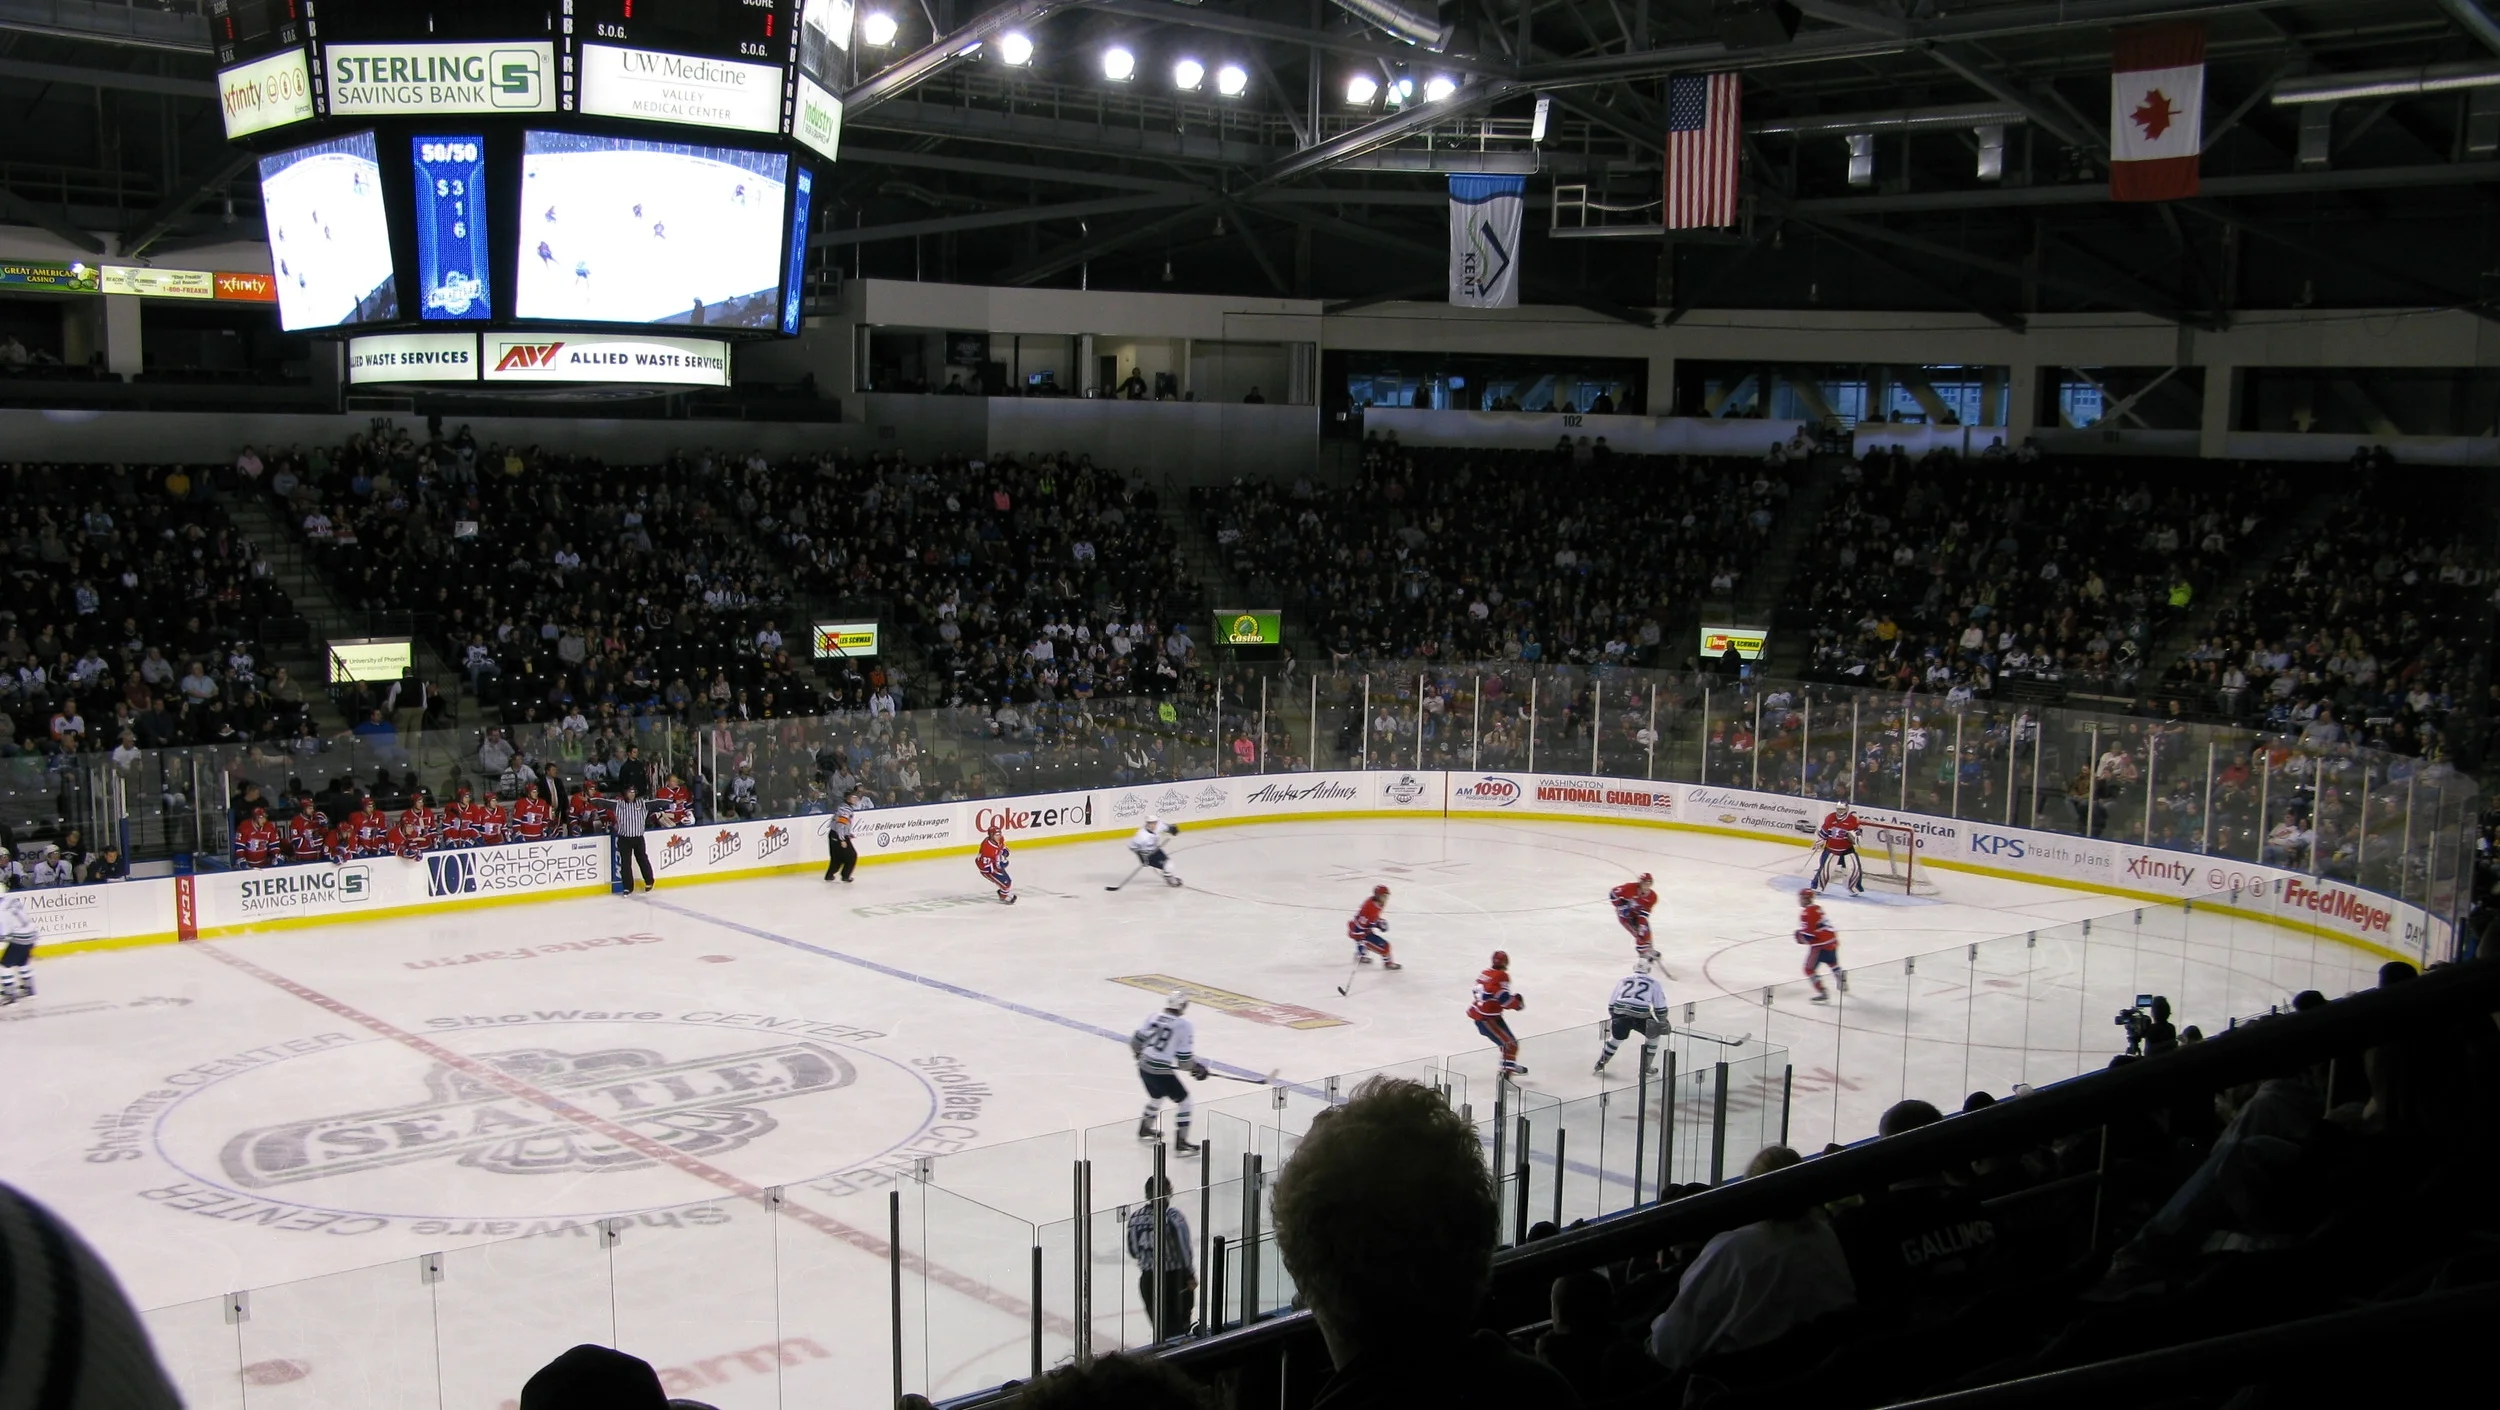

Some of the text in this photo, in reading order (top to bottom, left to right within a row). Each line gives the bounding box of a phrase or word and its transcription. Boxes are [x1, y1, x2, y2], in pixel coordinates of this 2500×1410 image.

[598, 23, 628, 39] S.O.G.
[740, 42, 768, 57] S.O.G.
[337, 56, 485, 83] STERLING
[622, 51, 747, 86] UW Medicine
[224, 80, 263, 118] xfinity
[337, 85, 486, 105] SAVINGS BANK
[662, 88, 705, 102] VALLEY
[632, 100, 732, 121] MEDICAL CENTER
[421, 143, 478, 163] 50/50
[452, 179, 465, 196] 3
[455, 201, 464, 216] 1
[453, 221, 467, 239] 6
[4, 266, 77, 279] GREAT AMERICAN
[27, 275, 56, 284] CASINO
[1464, 253, 1476, 300] KENT
[222, 278, 266, 294] xfinity
[365, 353, 397, 367] WASTE
[400, 351, 469, 365] SERVICES
[570, 352, 724, 371] ALLIED WASTE SERVICES
[1562, 415, 1583, 427] 102
[1229, 633, 1263, 642] Casino
[1247, 783, 1299, 804] Alaska
[1299, 780, 1357, 800] Airlines
[1455, 782, 1514, 796] AM 1090
[1539, 778, 1604, 789] WASHINGTON
[1537, 786, 1652, 807] NATIONAL GUARD
[1688, 789, 1740, 808] Chaplins
[1739, 801, 1758, 811] North
[1758, 803, 1776, 812] Bend
[1776, 805, 1807, 816] Chevrolet
[874, 820, 906, 832] Bellevue
[907, 816, 950, 830] Volkswagen
[1741, 816, 1794, 831] chaplins.com
[757, 830, 790, 859] Blue
[891, 830, 950, 844] chaplinsvw.com
[481, 845, 553, 863] VALLEY
[660, 842, 693, 870] Blue
[709, 836, 742, 865] Blue
[1971, 833, 2111, 868] KPS health plans
[428, 852, 477, 897] VOA
[480, 854, 598, 877] ORTHOPEDIC
[2127, 855, 2196, 886] xfinity
[241, 872, 336, 898] STERLING
[481, 868, 598, 891] ASSOCIATES
[30, 892, 97, 910] Medicine
[180, 879, 191, 926] CCM
[241, 890, 336, 912] SAVINGS BANK
[31, 914, 65, 925] VALLEY
[60, 921, 88, 931] CENTER
[1620, 980, 1650, 1002] 22
[424, 1009, 888, 1043] ShoWare CENTER
[1146, 1022, 1173, 1052] 28
[84, 1032, 356, 1164] ShoWare CENTER
[911, 1055, 993, 1122] ShoWare
[137, 1183, 737, 1240] ShoWare CENTER
